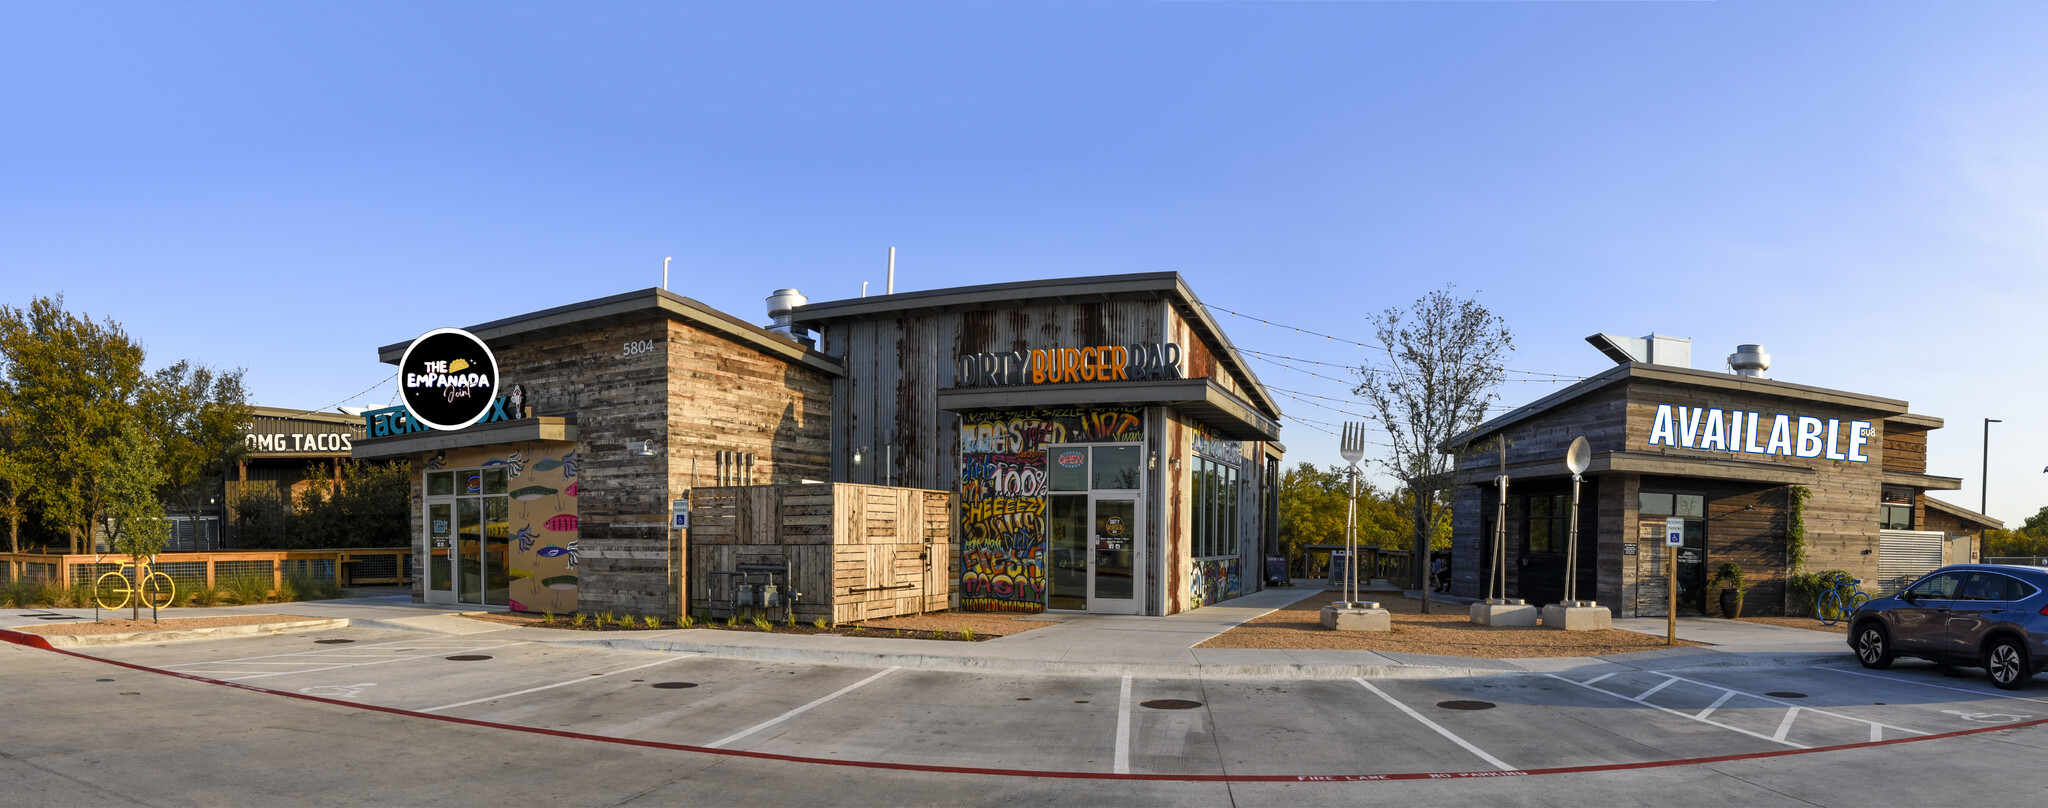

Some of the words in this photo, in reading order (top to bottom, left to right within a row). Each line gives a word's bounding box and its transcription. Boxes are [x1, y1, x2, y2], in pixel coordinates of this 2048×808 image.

[623, 339, 654, 356] 5804
[959, 350, 1031, 388] DIRTY
[1032, 345, 1128, 384] BURGER
[1130, 343, 1184, 380] BAR
[244, 434, 286, 452] OMG
[291, 433, 352, 451] TACOS
[1058, 454, 1084, 465] OPEN
[990, 465, 1048, 497] 100%
[962, 571, 1046, 603] TASTY
